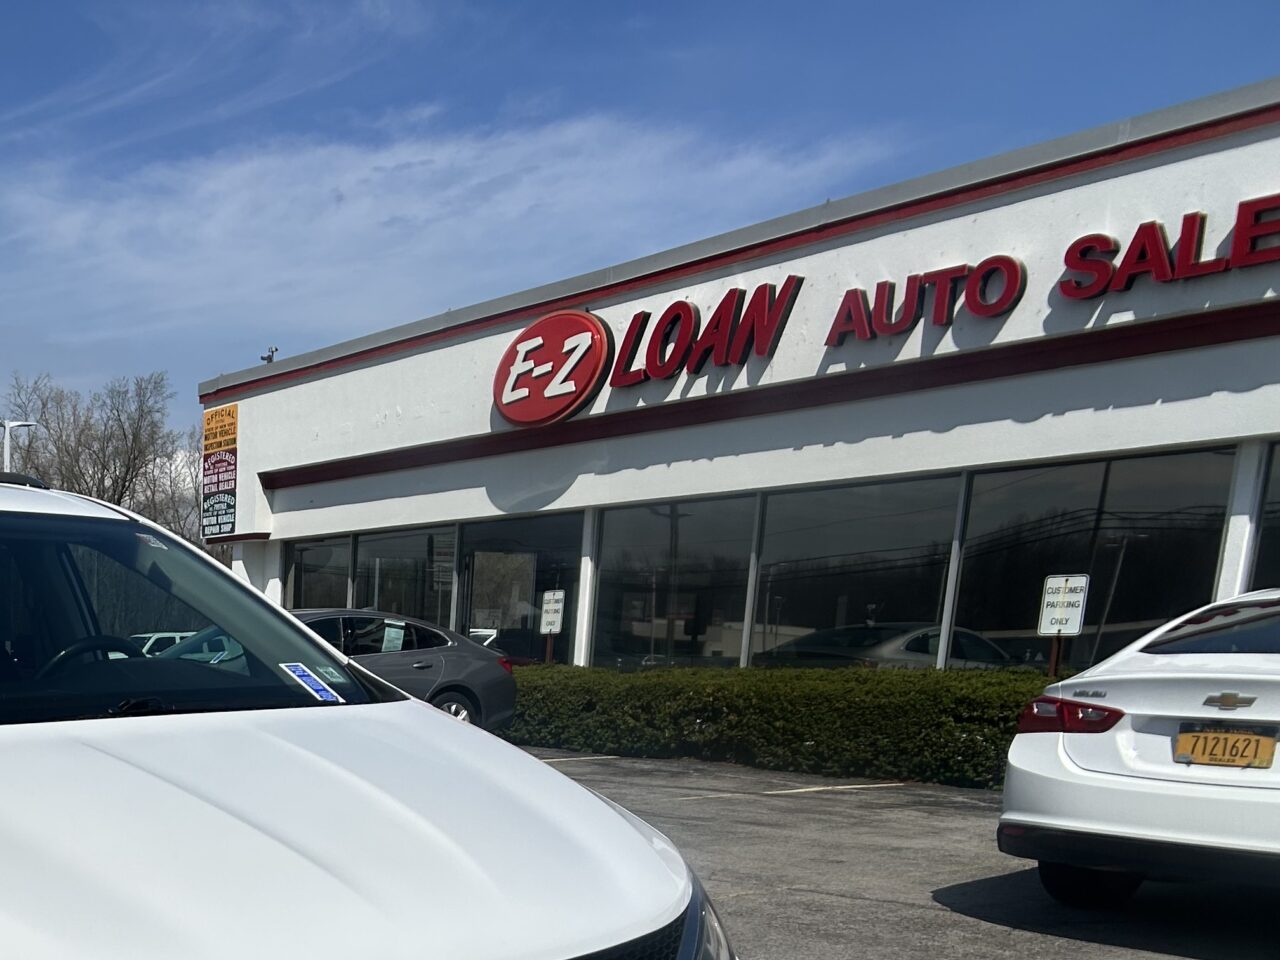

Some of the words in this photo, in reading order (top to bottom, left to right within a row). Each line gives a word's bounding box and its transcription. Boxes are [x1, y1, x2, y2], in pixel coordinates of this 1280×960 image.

[502, 332, 592, 405] E-Z
[609, 274, 805, 388] LOAN
[824, 254, 1027, 347] AUTO
[1059, 194, 1280, 301] SALE
[206, 409, 235, 426] OFFICIAL
[204, 431, 218, 441] MOTOR
[219, 426, 236, 438] VEHICLE
[204, 451, 236, 470] REGISTERED
[204, 474, 218, 485] MOTOR
[219, 470, 236, 482] VEHICLE
[204, 483, 218, 494] RETAIL
[218, 480, 235, 491] DEALER
[203, 493, 235, 510] REGISTERED
[203, 516, 217, 526] MOTOR
[218, 513, 235, 524] VEHICLE
[205, 525, 219, 535] REPAIR
[220, 523, 233, 532] SHOP
[1046, 586, 1085, 595] CUSTOMER
[1046, 600, 1081, 609] PARKING
[1050, 617, 1070, 625] ONLY
[1191, 735, 1261, 760] 7121621
